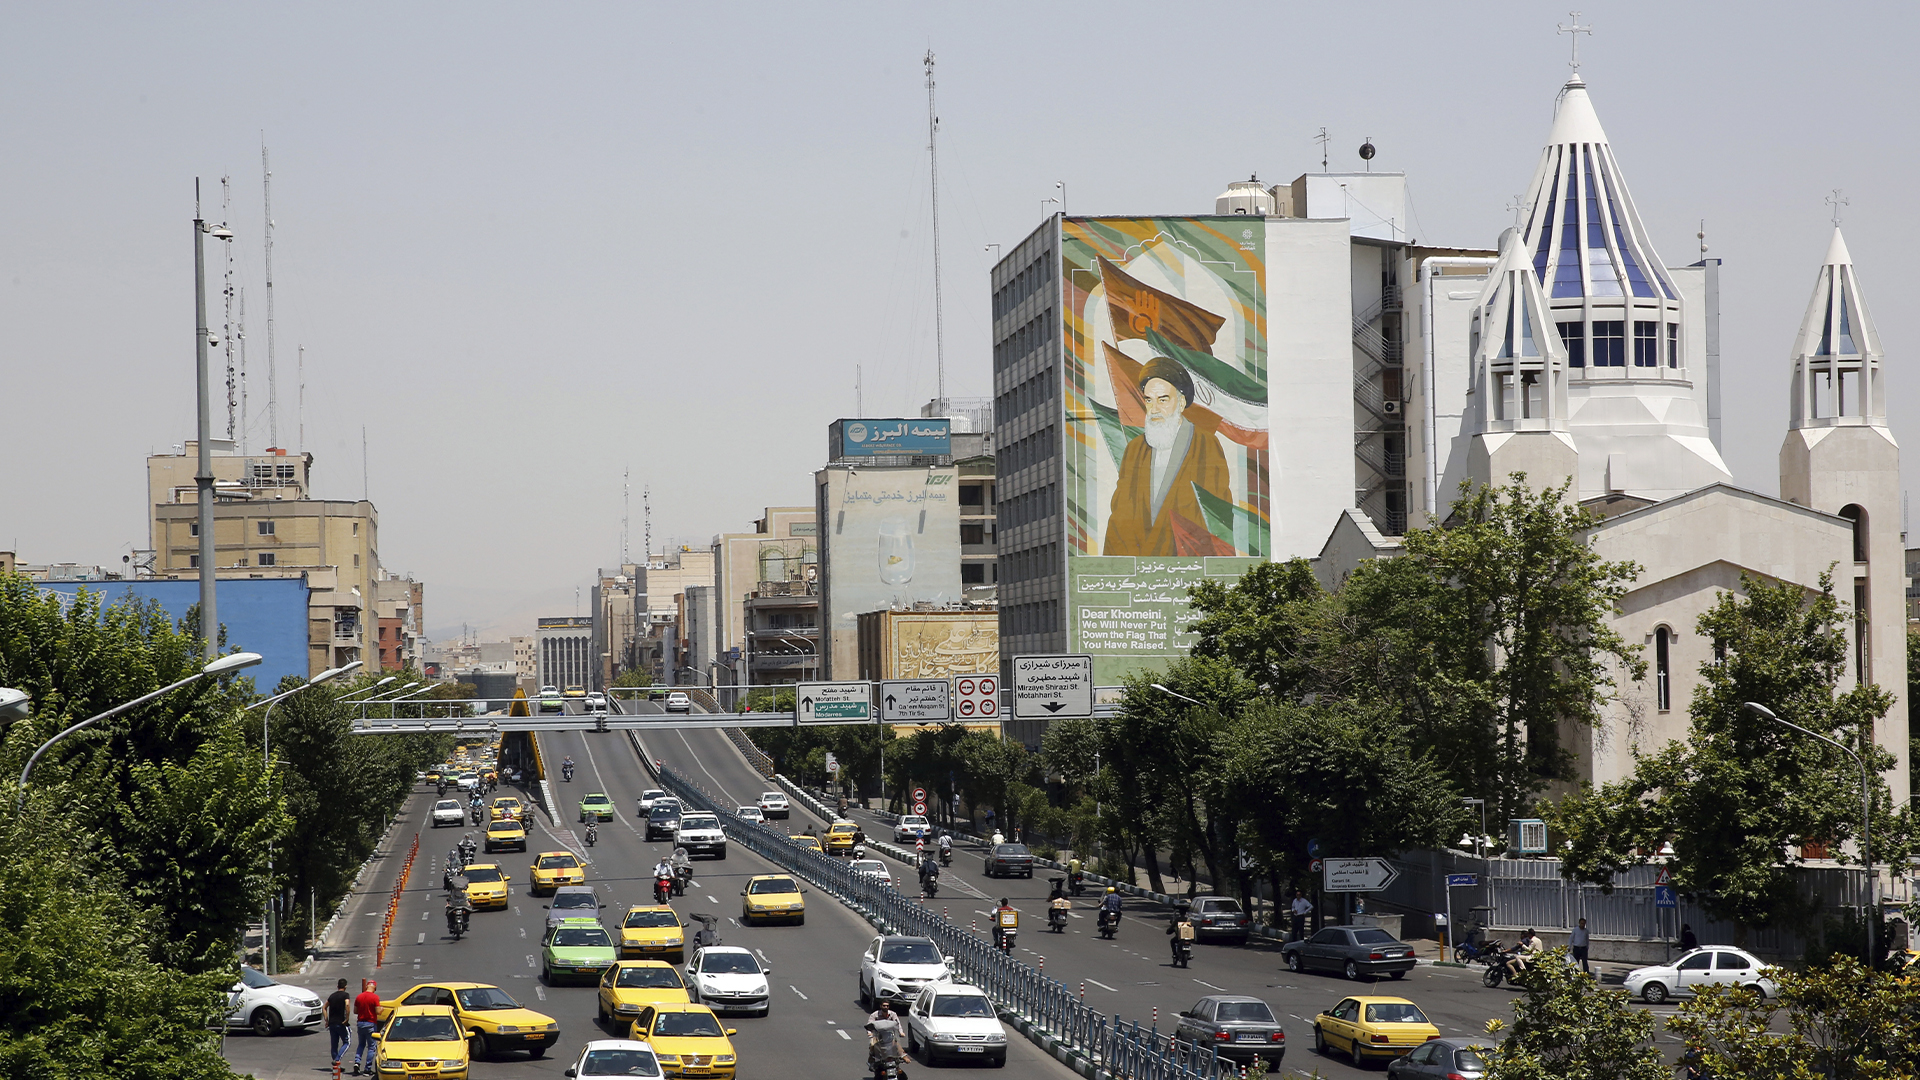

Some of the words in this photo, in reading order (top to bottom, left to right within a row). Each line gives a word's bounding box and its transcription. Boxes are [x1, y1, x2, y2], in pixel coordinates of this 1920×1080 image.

[870, 423, 909, 442] البرز
[911, 426, 947, 440] بیمه
[843, 490, 872, 504] متمایز
[872, 490, 904, 504] خدمتی
[906, 490, 927, 503] البرز
[928, 493, 947, 502] بیمه
[1167, 561, 1203, 573] خمینی
[1081, 578, 1105, 590] زمین
[1105, 580, 1116, 591] به
[1116, 577, 1147, 590] هرگز
[1082, 609, 1109, 619] Dear
[1082, 620, 1098, 629] We
[1100, 620, 1118, 629] Will
[1120, 620, 1148, 629] Never
[1150, 621, 1167, 630] Put
[1082, 630, 1108, 639] Down
[1110, 631, 1124, 639] the
[1126, 631, 1146, 641] Flag
[1148, 631, 1167, 640] That
[1082, 640, 1101, 649] You
[1104, 640, 1128, 649] Have
[1130, 641, 1167, 650] Raised.
[1019, 660, 1051, 671] شیرازی
[1051, 660, 1081, 670] میرزای
[1027, 673, 1057, 683] مطهری
[1058, 672, 1080, 682] شهید
[821, 687, 838, 696] مفتح
[839, 686, 857, 694] شهید
[905, 685, 921, 694] مقام
[921, 684, 937, 694] قائم
[1017, 684, 1044, 692] Mirzaye
[908, 696, 919, 704] تیر
[1053, 691, 1064, 699] St.
[815, 703, 838, 712] مدرس
[840, 702, 858, 711] شهید
